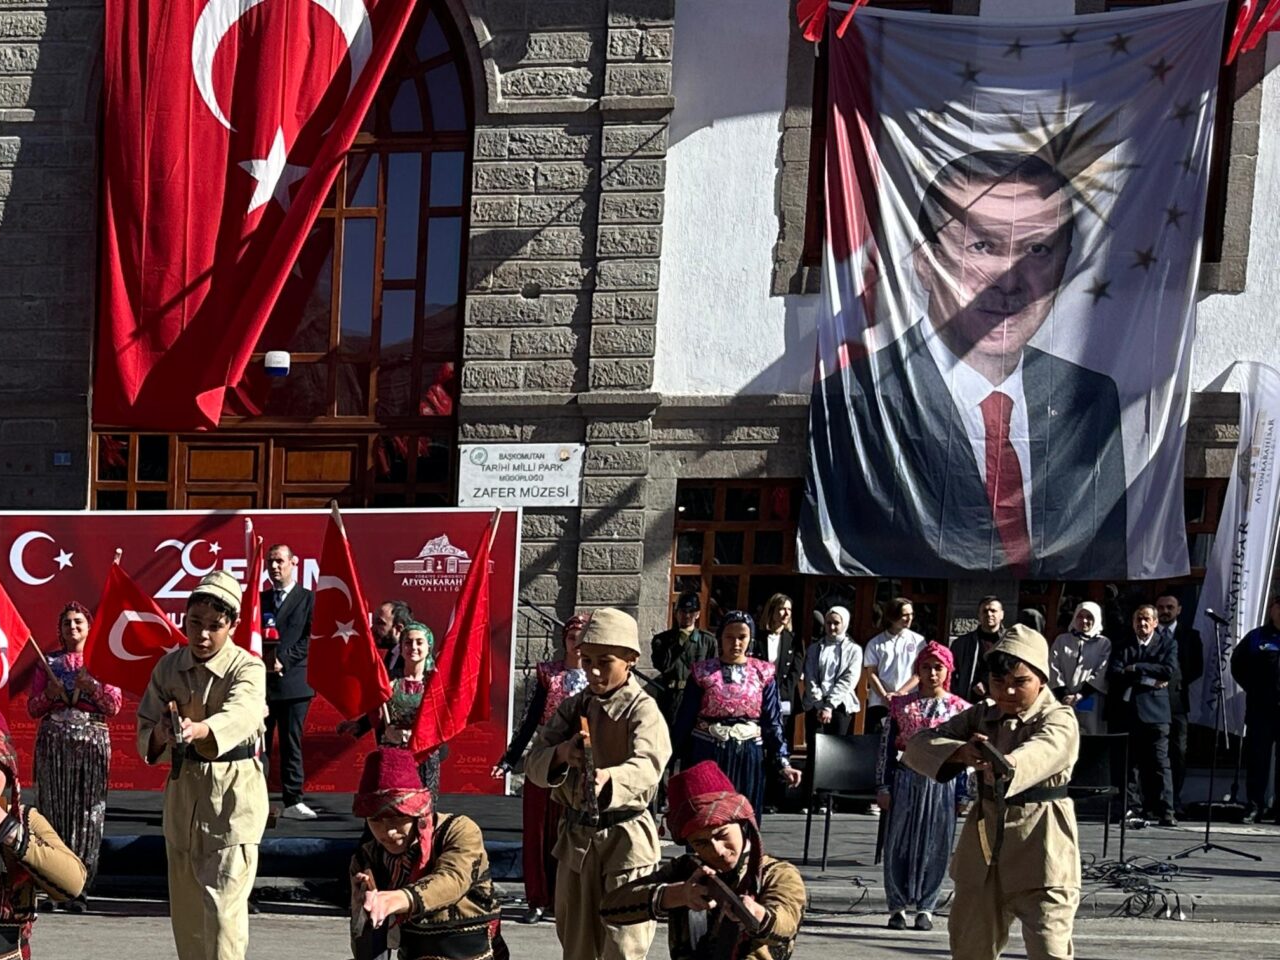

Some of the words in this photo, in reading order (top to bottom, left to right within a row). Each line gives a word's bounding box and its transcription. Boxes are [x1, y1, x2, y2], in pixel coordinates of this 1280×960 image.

[499, 452, 545, 461] BAŞKOMUTAN
[481, 463, 510, 472] TARİHİ
[513, 463, 536, 471] MİLLİ
[538, 463, 563, 471] PARK
[473, 487, 516, 498] ZAFER
[520, 485, 569, 498] MÜZESİ
[401, 577, 463, 586] AFYONKARAH
